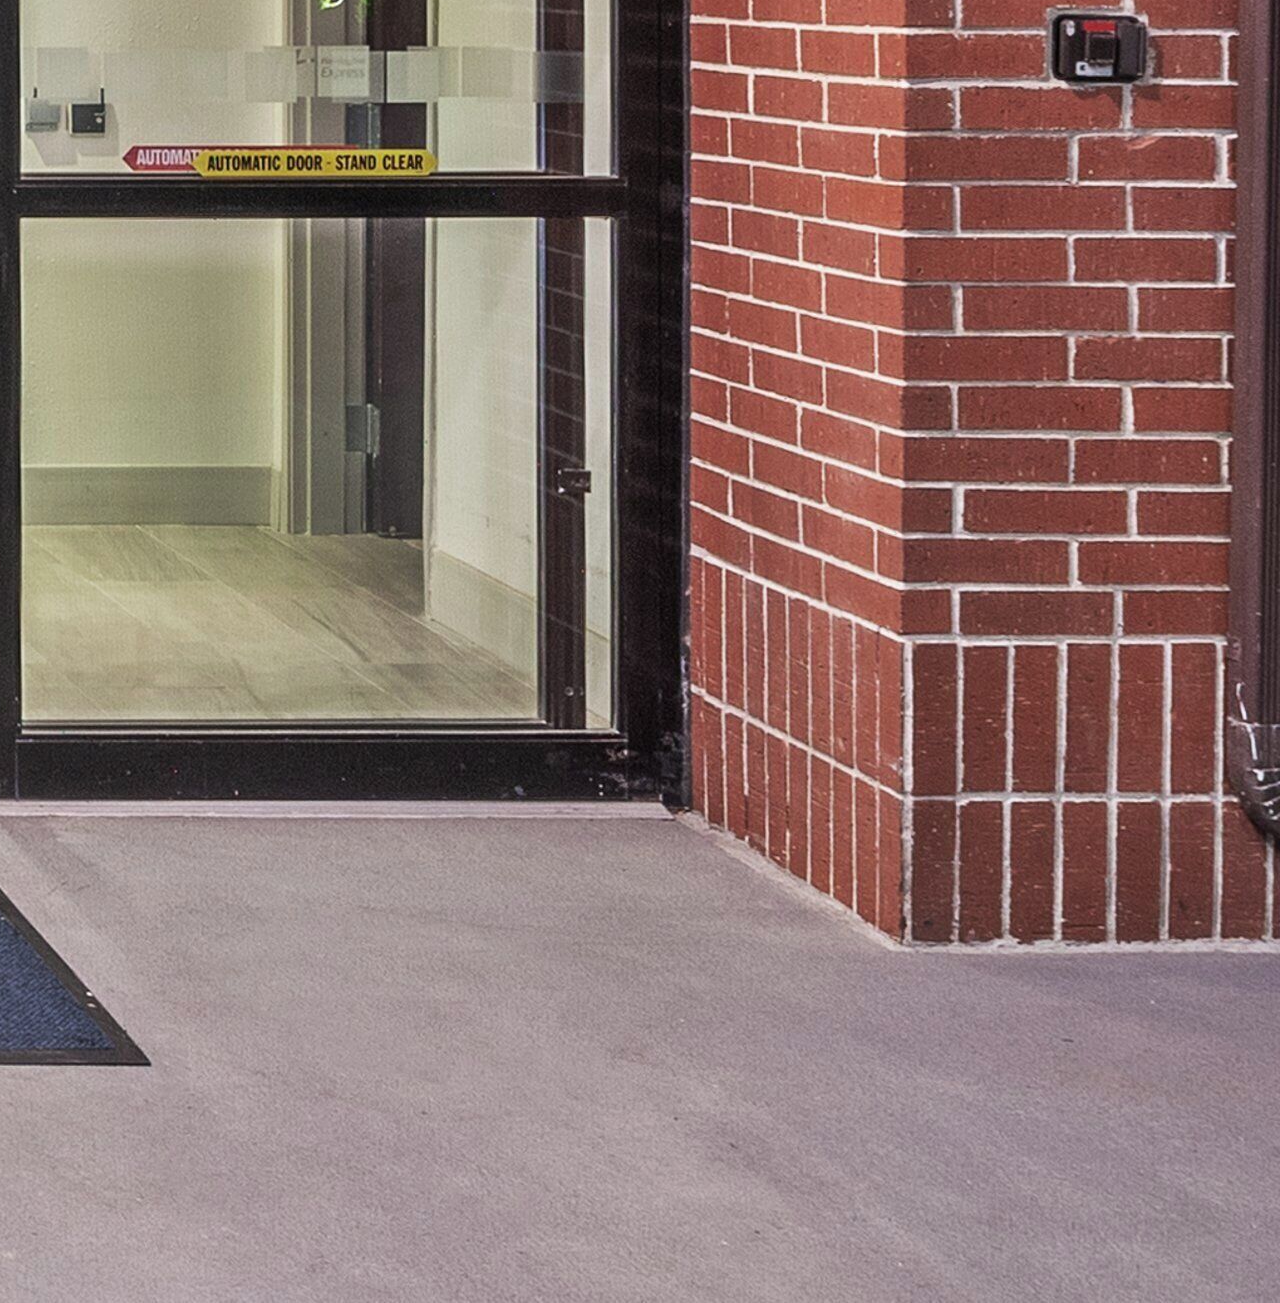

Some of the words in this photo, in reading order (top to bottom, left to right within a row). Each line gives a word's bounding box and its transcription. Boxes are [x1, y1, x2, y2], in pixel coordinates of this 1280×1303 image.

[136, 149, 200, 165] AUTOMAT
[207, 155, 281, 171] AUTOMATIC
[286, 155, 323, 171] DOOR
[335, 154, 377, 170] STAND
[382, 154, 424, 170] CLEAR
